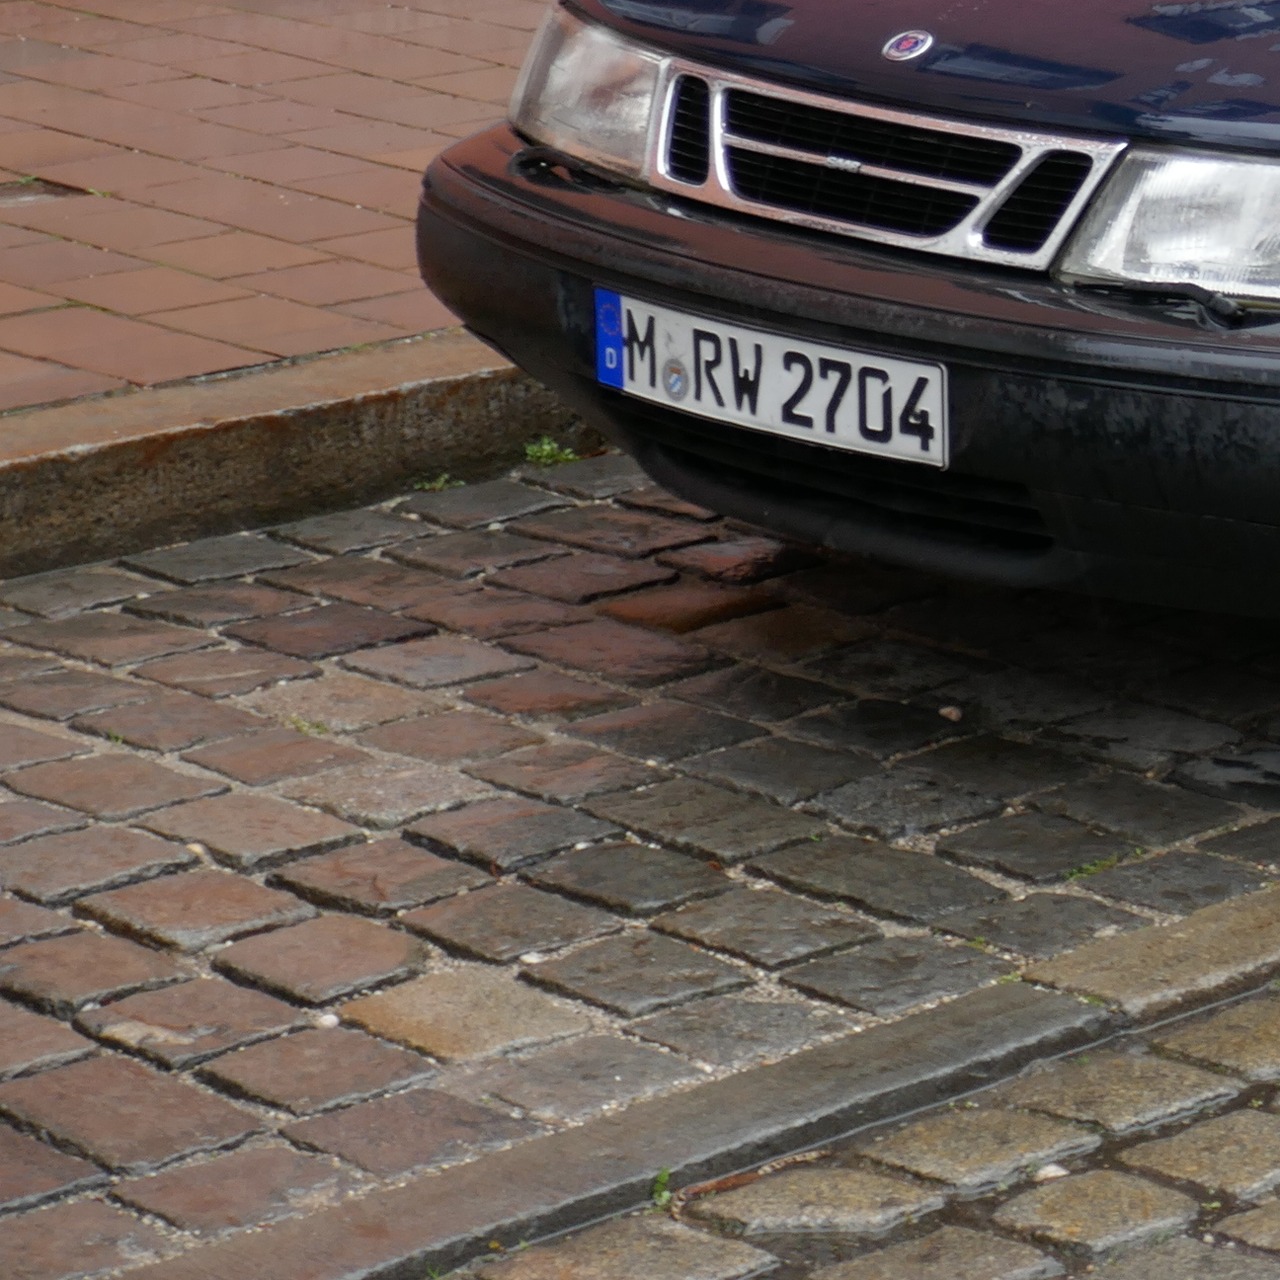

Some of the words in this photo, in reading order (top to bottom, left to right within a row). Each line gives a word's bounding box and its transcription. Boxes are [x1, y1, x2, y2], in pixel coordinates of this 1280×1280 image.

[605, 347, 617, 369] D
[625, 308, 656, 389] M
[693, 328, 762, 416] RW
[781, 351, 935, 452] 2704
